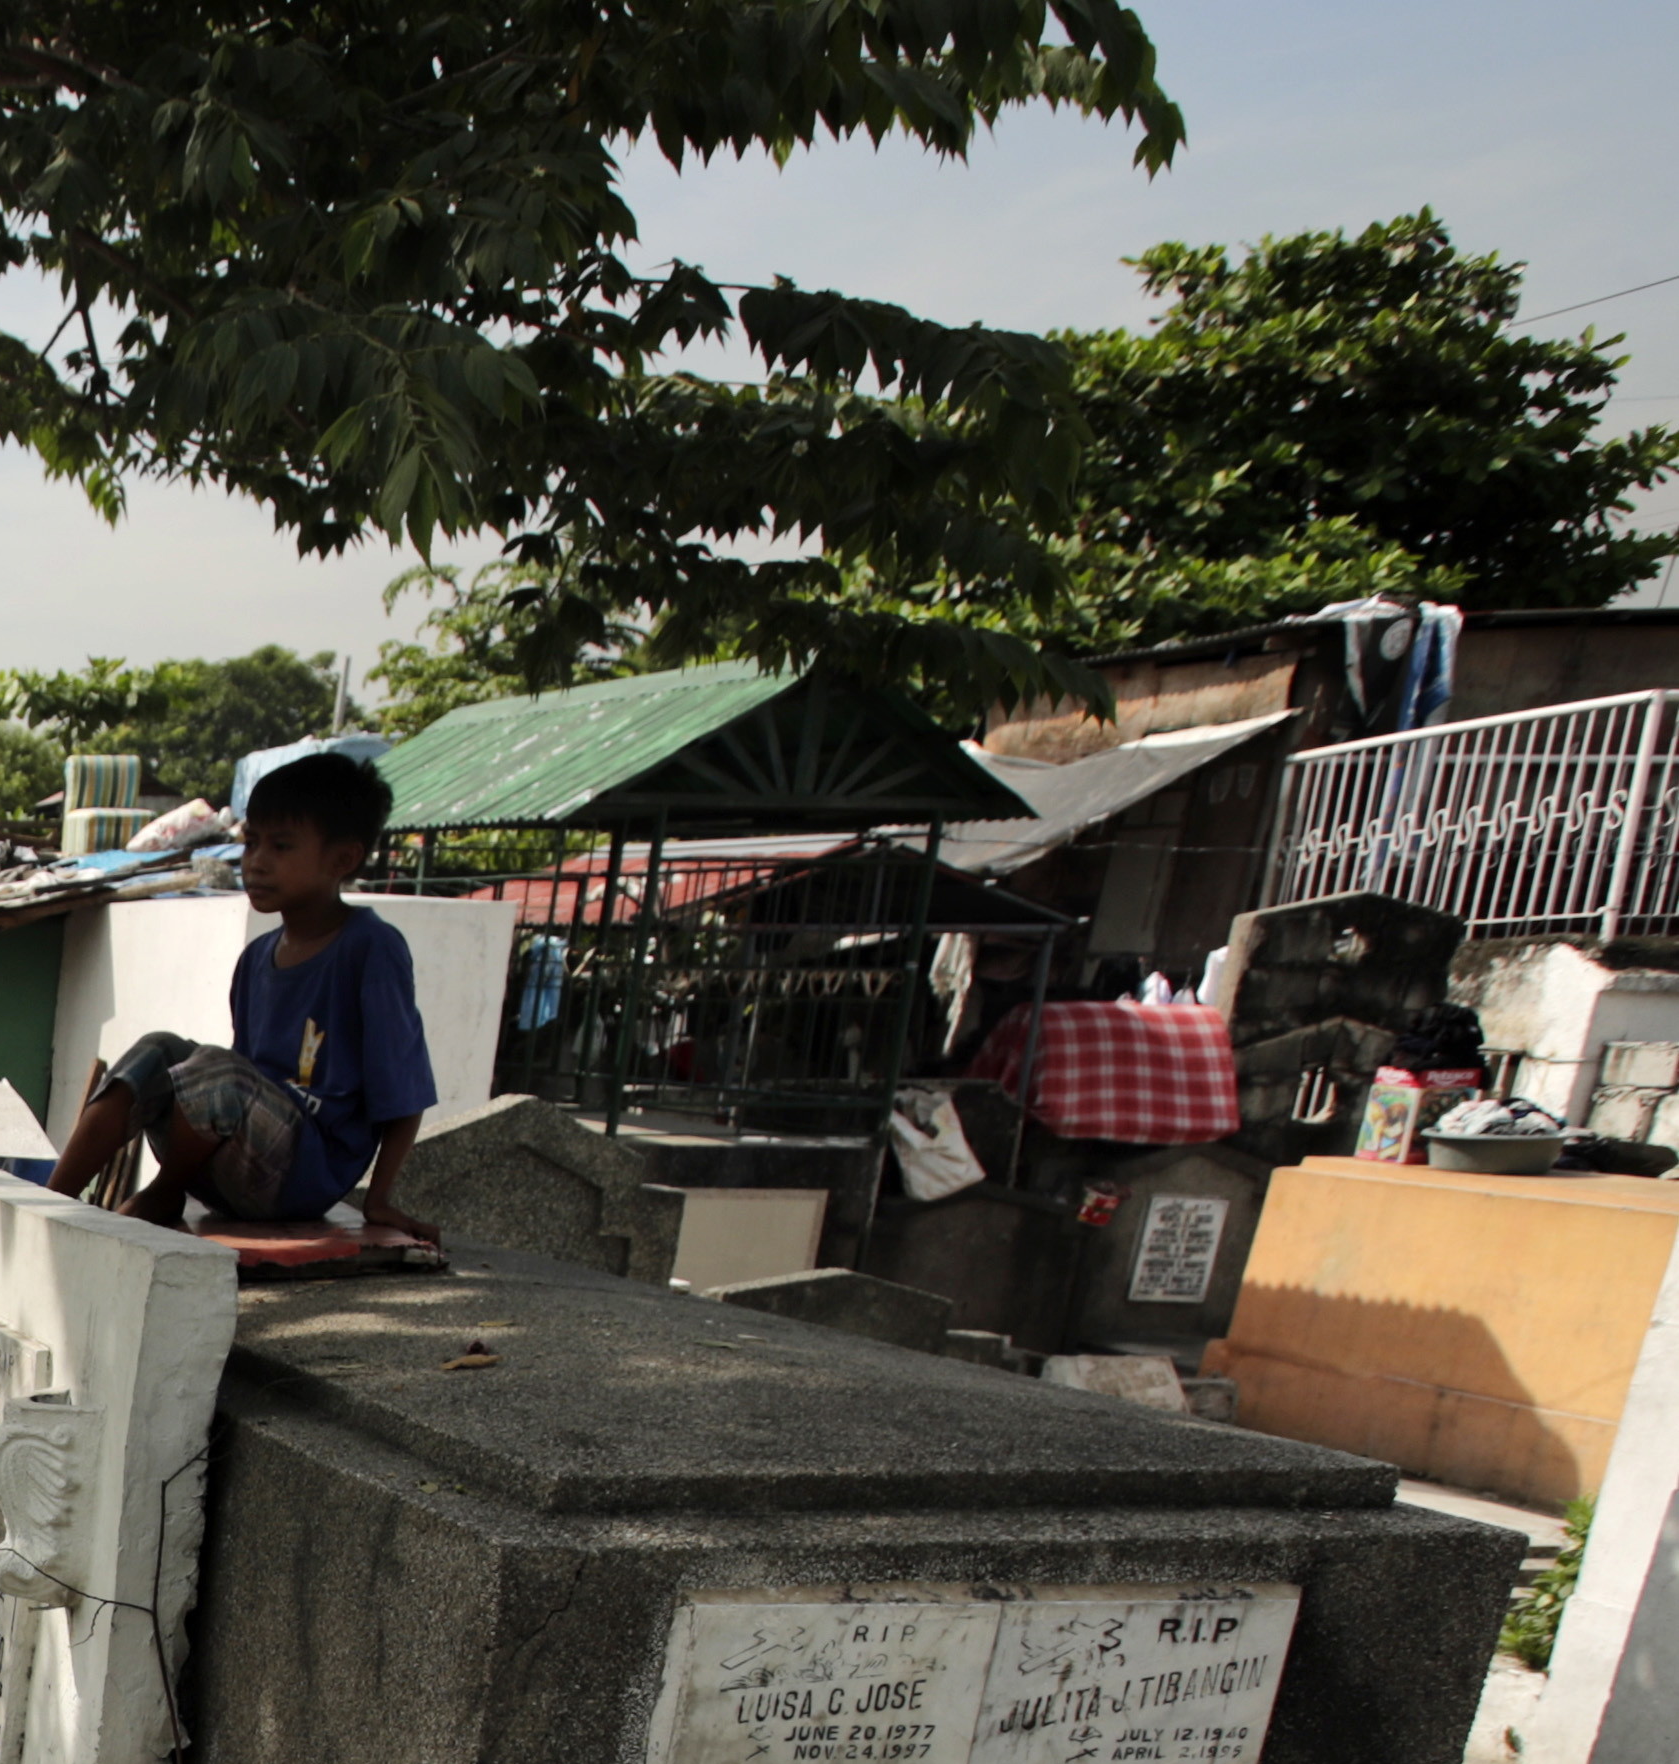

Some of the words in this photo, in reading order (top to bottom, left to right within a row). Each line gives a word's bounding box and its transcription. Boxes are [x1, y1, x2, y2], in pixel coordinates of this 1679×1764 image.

[737, 1688, 813, 1725] LUISA
[855, 1679, 927, 1714] JOSE
[999, 1686, 1102, 1734] JULITA
[783, 1724, 840, 1743] JUNE
[1116, 1727, 1165, 1744] JULY
[793, 1744, 838, 1761] NOV.
[1111, 1745, 1168, 1762] APRIL
